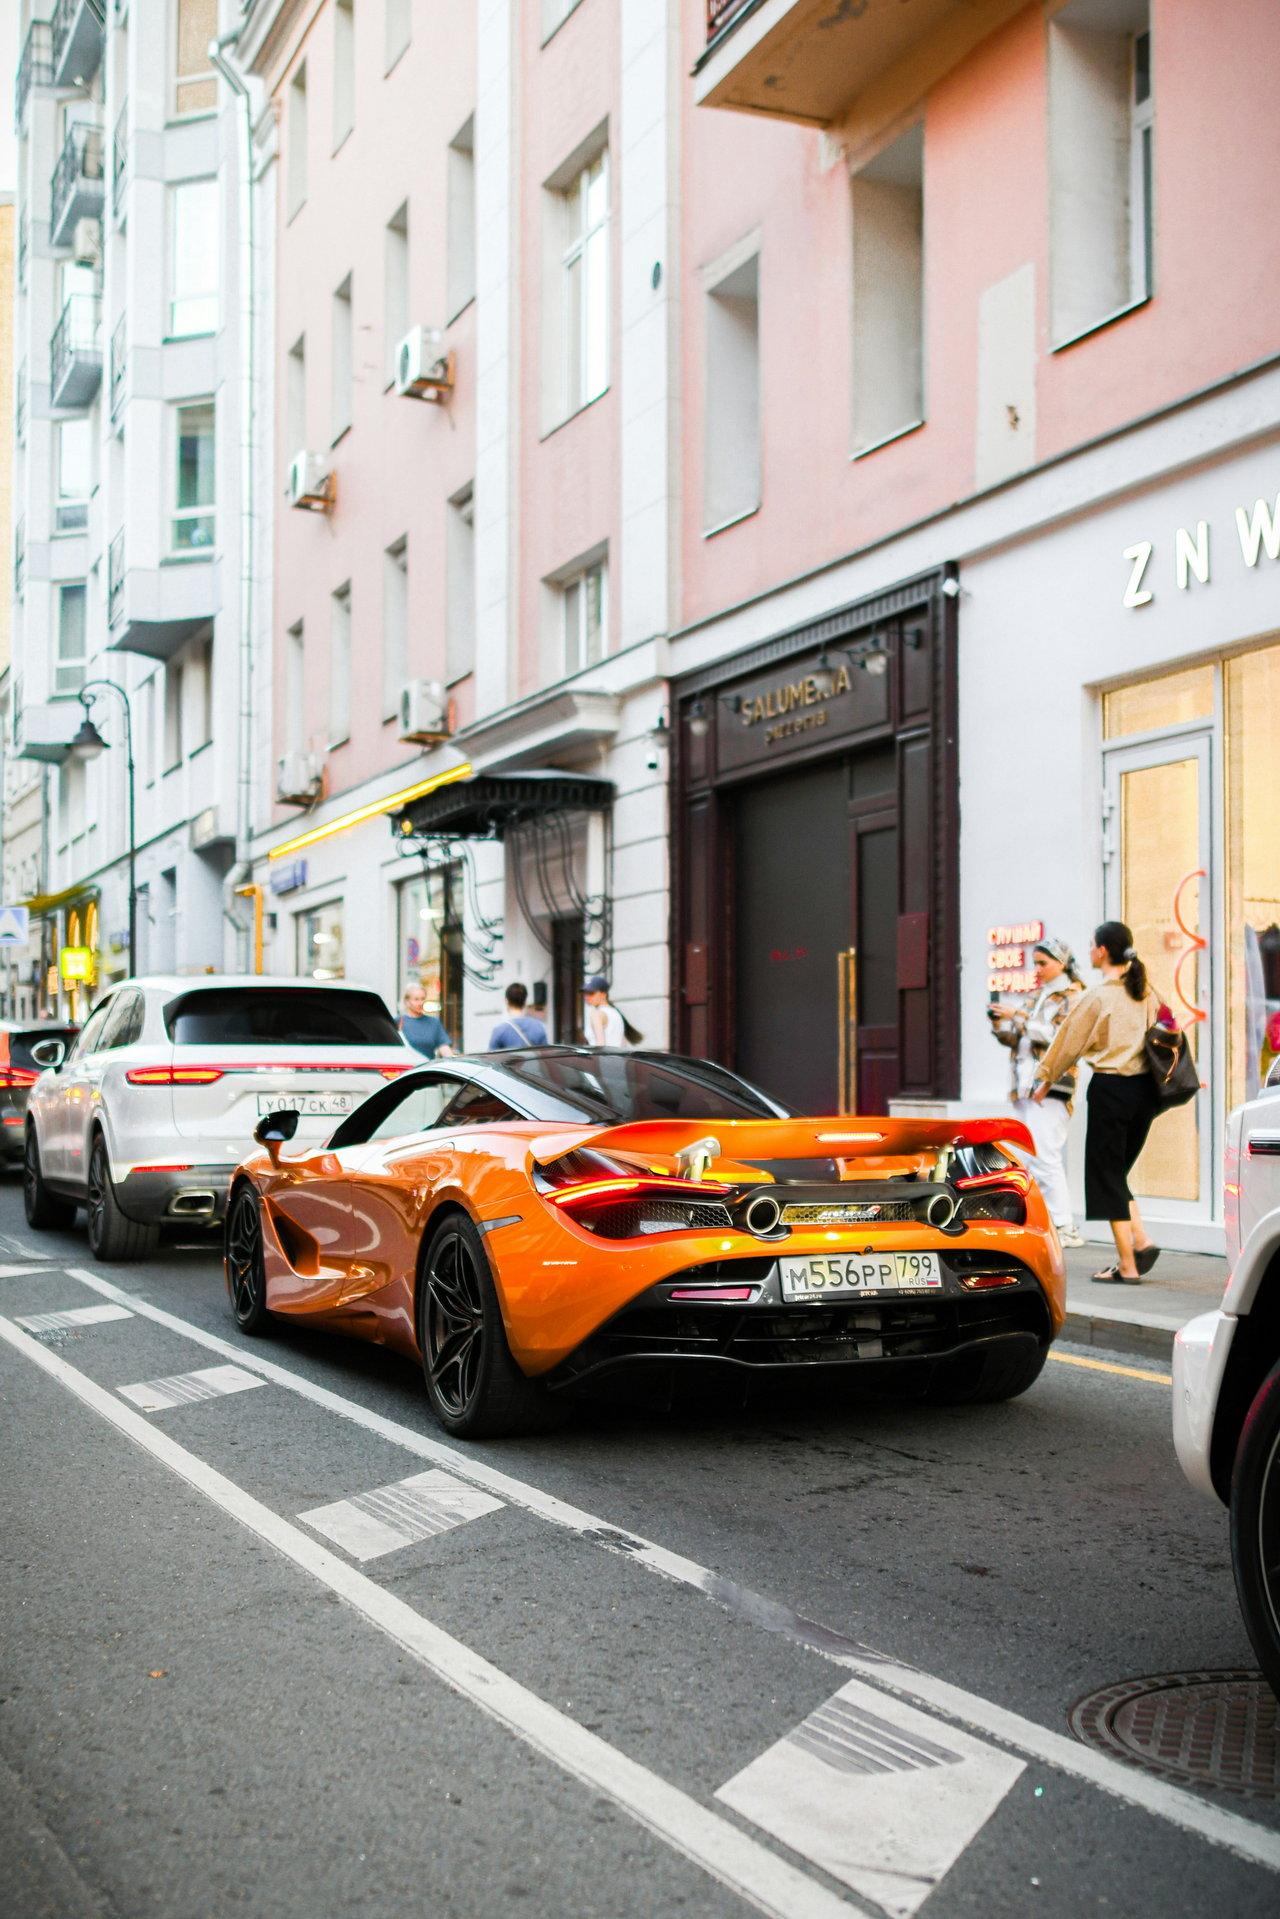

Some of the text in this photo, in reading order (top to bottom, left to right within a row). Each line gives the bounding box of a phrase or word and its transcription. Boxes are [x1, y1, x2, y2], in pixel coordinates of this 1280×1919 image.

[789, 1255, 932, 1291] М556РР 799
[908, 1277, 927, 1286] RUS
